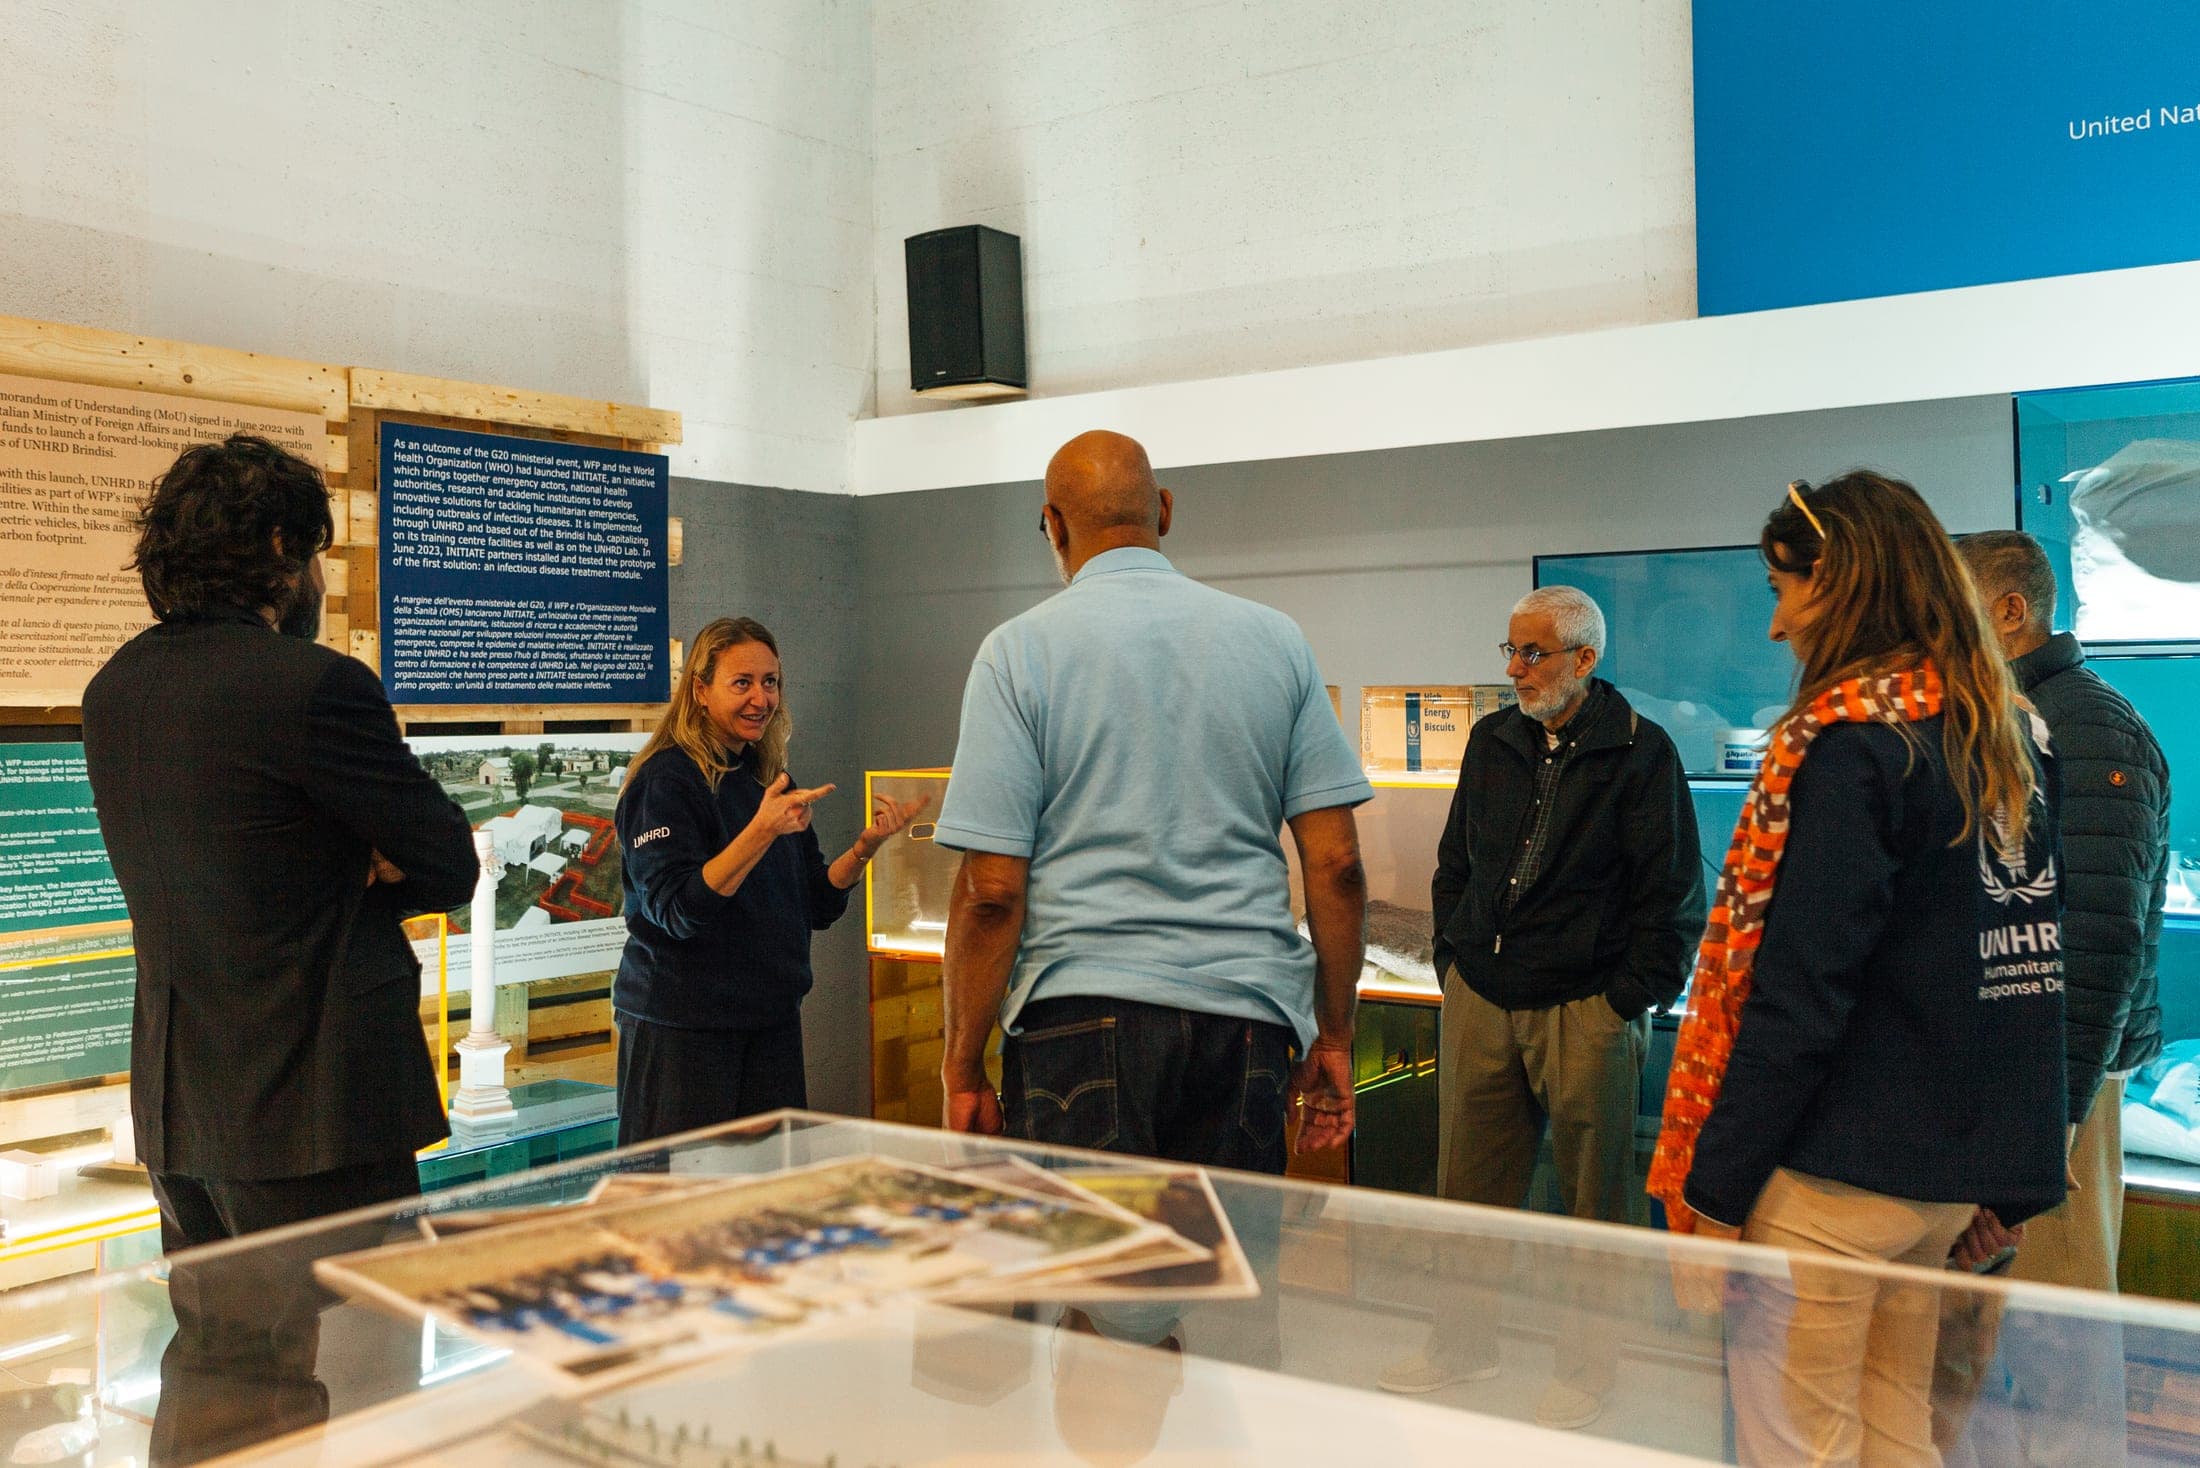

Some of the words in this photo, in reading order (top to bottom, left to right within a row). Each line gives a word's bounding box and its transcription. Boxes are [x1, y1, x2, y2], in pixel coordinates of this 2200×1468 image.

[2068, 108, 2151, 140] United
[33, 410, 78, 423] Ministry
[81, 415, 92, 426] of
[95, 416, 134, 432] Foreign
[137, 422, 170, 434] Affairs
[172, 427, 190, 437] and
[61, 398, 72, 408] of
[75, 399, 151, 420] Understanding
[189, 416, 220, 426] signed
[234, 419, 257, 432] June
[285, 426, 304, 436] with
[2, 421, 33, 434] funds
[36, 426, 47, 435] to
[50, 426, 86, 440] launch
[97, 431, 179, 452] forward-looking
[8, 438, 20, 448] of
[23, 439, 69, 452] UNHRD
[73, 444, 116, 458] Brindisi.
[394, 438, 406, 449] As
[408, 442, 420, 450] an
[422, 443, 461, 455] outcome
[463, 446, 473, 456] of
[474, 448, 489, 458] the
[491, 449, 509, 460] G20
[511, 453, 554, 465] ministerial
[556, 459, 581, 469] event,
[583, 460, 600, 470] WFP
[602, 463, 617, 472] and
[618, 464, 631, 473] the
[633, 466, 655, 476] World
[394, 452, 424, 463] Health
[426, 455, 482, 469] Organization
[484, 461, 514, 475] (WHO)
[516, 465, 532, 475] had
[534, 466, 570, 479] launched
[572, 471, 609, 484] INITIATE,
[623, 477, 655, 488] initiative
[26, 470, 46, 481] this
[92, 476, 135, 488] UNHRD
[394, 465, 420, 476] which
[423, 467, 451, 481] brings
[453, 471, 491, 483] together
[492, 476, 539, 489] emergency
[540, 481, 568, 492] actors,
[570, 484, 602, 494] national
[604, 486, 628, 496] health
[50, 490, 71, 500] part
[74, 489, 85, 499] of
[88, 490, 120, 502] WFP's
[393, 479, 445, 493] authorities,
[448, 485, 485, 495] research
[487, 488, 504, 497] and
[506, 490, 545, 501] academic
[547, 493, 591, 505] institutions
[592, 497, 601, 506] to
[603, 498, 632, 510] develop
[393, 491, 440, 504] innovative
[442, 496, 482, 508] solutions
[484, 498, 497, 508] for
[498, 501, 531, 514] tackling
[533, 503, 586, 516] humanitarian
[588, 510, 639, 522] emergencies,
[32, 501, 69, 513] Within
[72, 504, 89, 515] the
[92, 508, 119, 517] same
[393, 504, 434, 518] including
[436, 509, 480, 520] outbreaks
[482, 512, 492, 521] of
[494, 512, 534, 524] infectious
[536, 516, 573, 527] diseases.
[575, 519, 582, 528] It
[584, 520, 591, 529] is
[593, 521, 642, 533] implemented
[34, 516, 80, 530] vehicles,
[83, 519, 110, 531] bikes
[113, 521, 132, 533] and
[393, 517, 429, 530] through
[432, 520, 465, 531] UNHRD
[467, 524, 484, 533] and
[486, 524, 511, 535] based
[513, 528, 528, 536] out
[529, 528, 538, 537] of
[540, 528, 554, 538] the
[556, 530, 585, 540] Brindisi
[587, 532, 604, 543] hub,
[606, 535, 648, 547] capitalizing
[36, 531, 86, 545] footprint.
[392, 532, 405, 540] on
[407, 531, 419, 541] its
[421, 533, 456, 546] training
[458, 536, 486, 546] centre
[488, 536, 523, 548] facilities
[524, 541, 535, 549] as
[536, 541, 553, 550] well
[579, 544, 592, 553] the
[594, 545, 622, 554] UNHRD
[624, 547, 640, 556] Lab.
[392, 543, 415, 554] June
[417, 544, 443, 557] 2023,
[446, 546, 485, 558] INITIATE
[487, 551, 523, 560] partners
[525, 552, 560, 563] installed
[561, 555, 577, 564] and
[578, 556, 603, 565] tested
[605, 557, 618, 566] the
[620, 560, 656, 569] prototype
[392, 556, 403, 566] of
[404, 557, 420, 567] the
[422, 558, 441, 568] first
[443, 560, 481, 570] solution:
[497, 562, 537, 574] infectious
[539, 565, 570, 575] disease
[571, 568, 610, 578] treatment
[612, 570, 643, 579] module.
[1424, 708, 1452, 719] Energy
[1424, 722, 1456, 732] Biscuits
[633, 826, 671, 849] UNHRD
